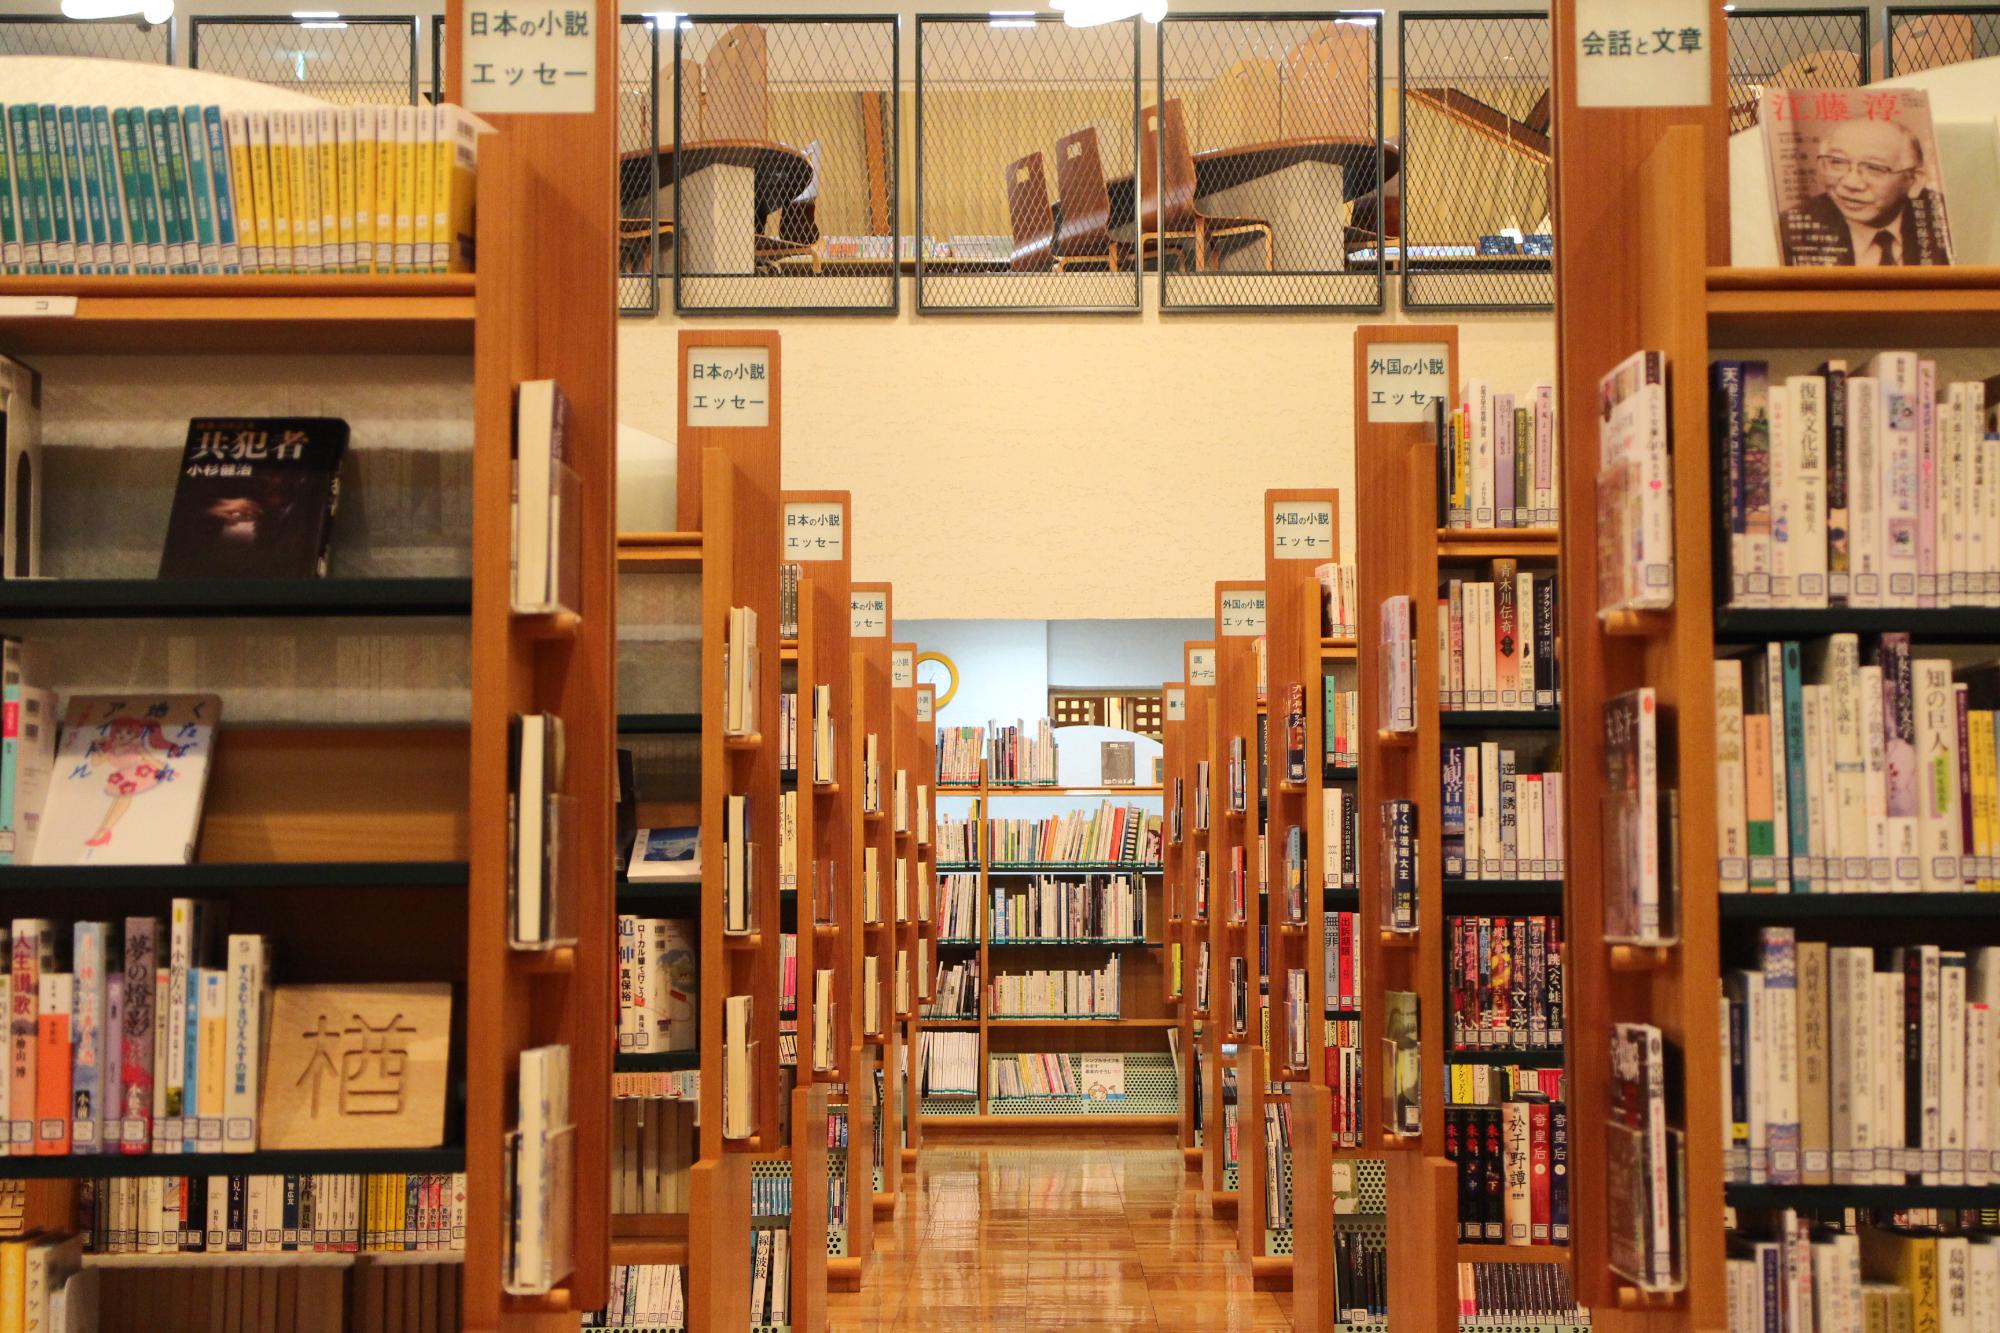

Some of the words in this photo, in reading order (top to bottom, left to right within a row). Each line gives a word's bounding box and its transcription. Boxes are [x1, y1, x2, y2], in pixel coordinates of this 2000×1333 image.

[469, 10, 590, 38] 日本の小説
[1581, 27, 1703, 57] 会話と文章
[470, 61, 589, 86] エッセー
[1772, 92, 1904, 121] 江藤淳
[692, 362, 766, 381] 日本の小説
[1370, 357, 1445, 376] 外国の小説
[692, 393, 765, 412] エッセー
[1371, 389, 1445, 406] エッセー
[189, 430, 311, 461] 共犯者
[787, 512, 841, 528] 日本の小説
[1275, 511, 1330, 527] 外国の小説
[787, 535, 840, 549] エッセー
[1276, 534, 1331, 548] エッセー
[1222, 599, 1265, 611] 外国の小説
[1223, 617, 1265, 627] エッセー
[1926, 668, 1949, 753] 知の巨人
[1502, 762, 1516, 828] 逆向誘拐
[1399, 803, 1410, 880] ぼくは漫画大王
[618, 918, 635, 964] 追伸
[1325, 916, 1339, 947] 無罪
[621, 968, 632, 1010] 真保裕一
[1532, 1113, 1547, 1161] 奇皇后
[1553, 1113, 1568, 1161] 奇皇后
[754, 1234, 769, 1279] 線の波紋
